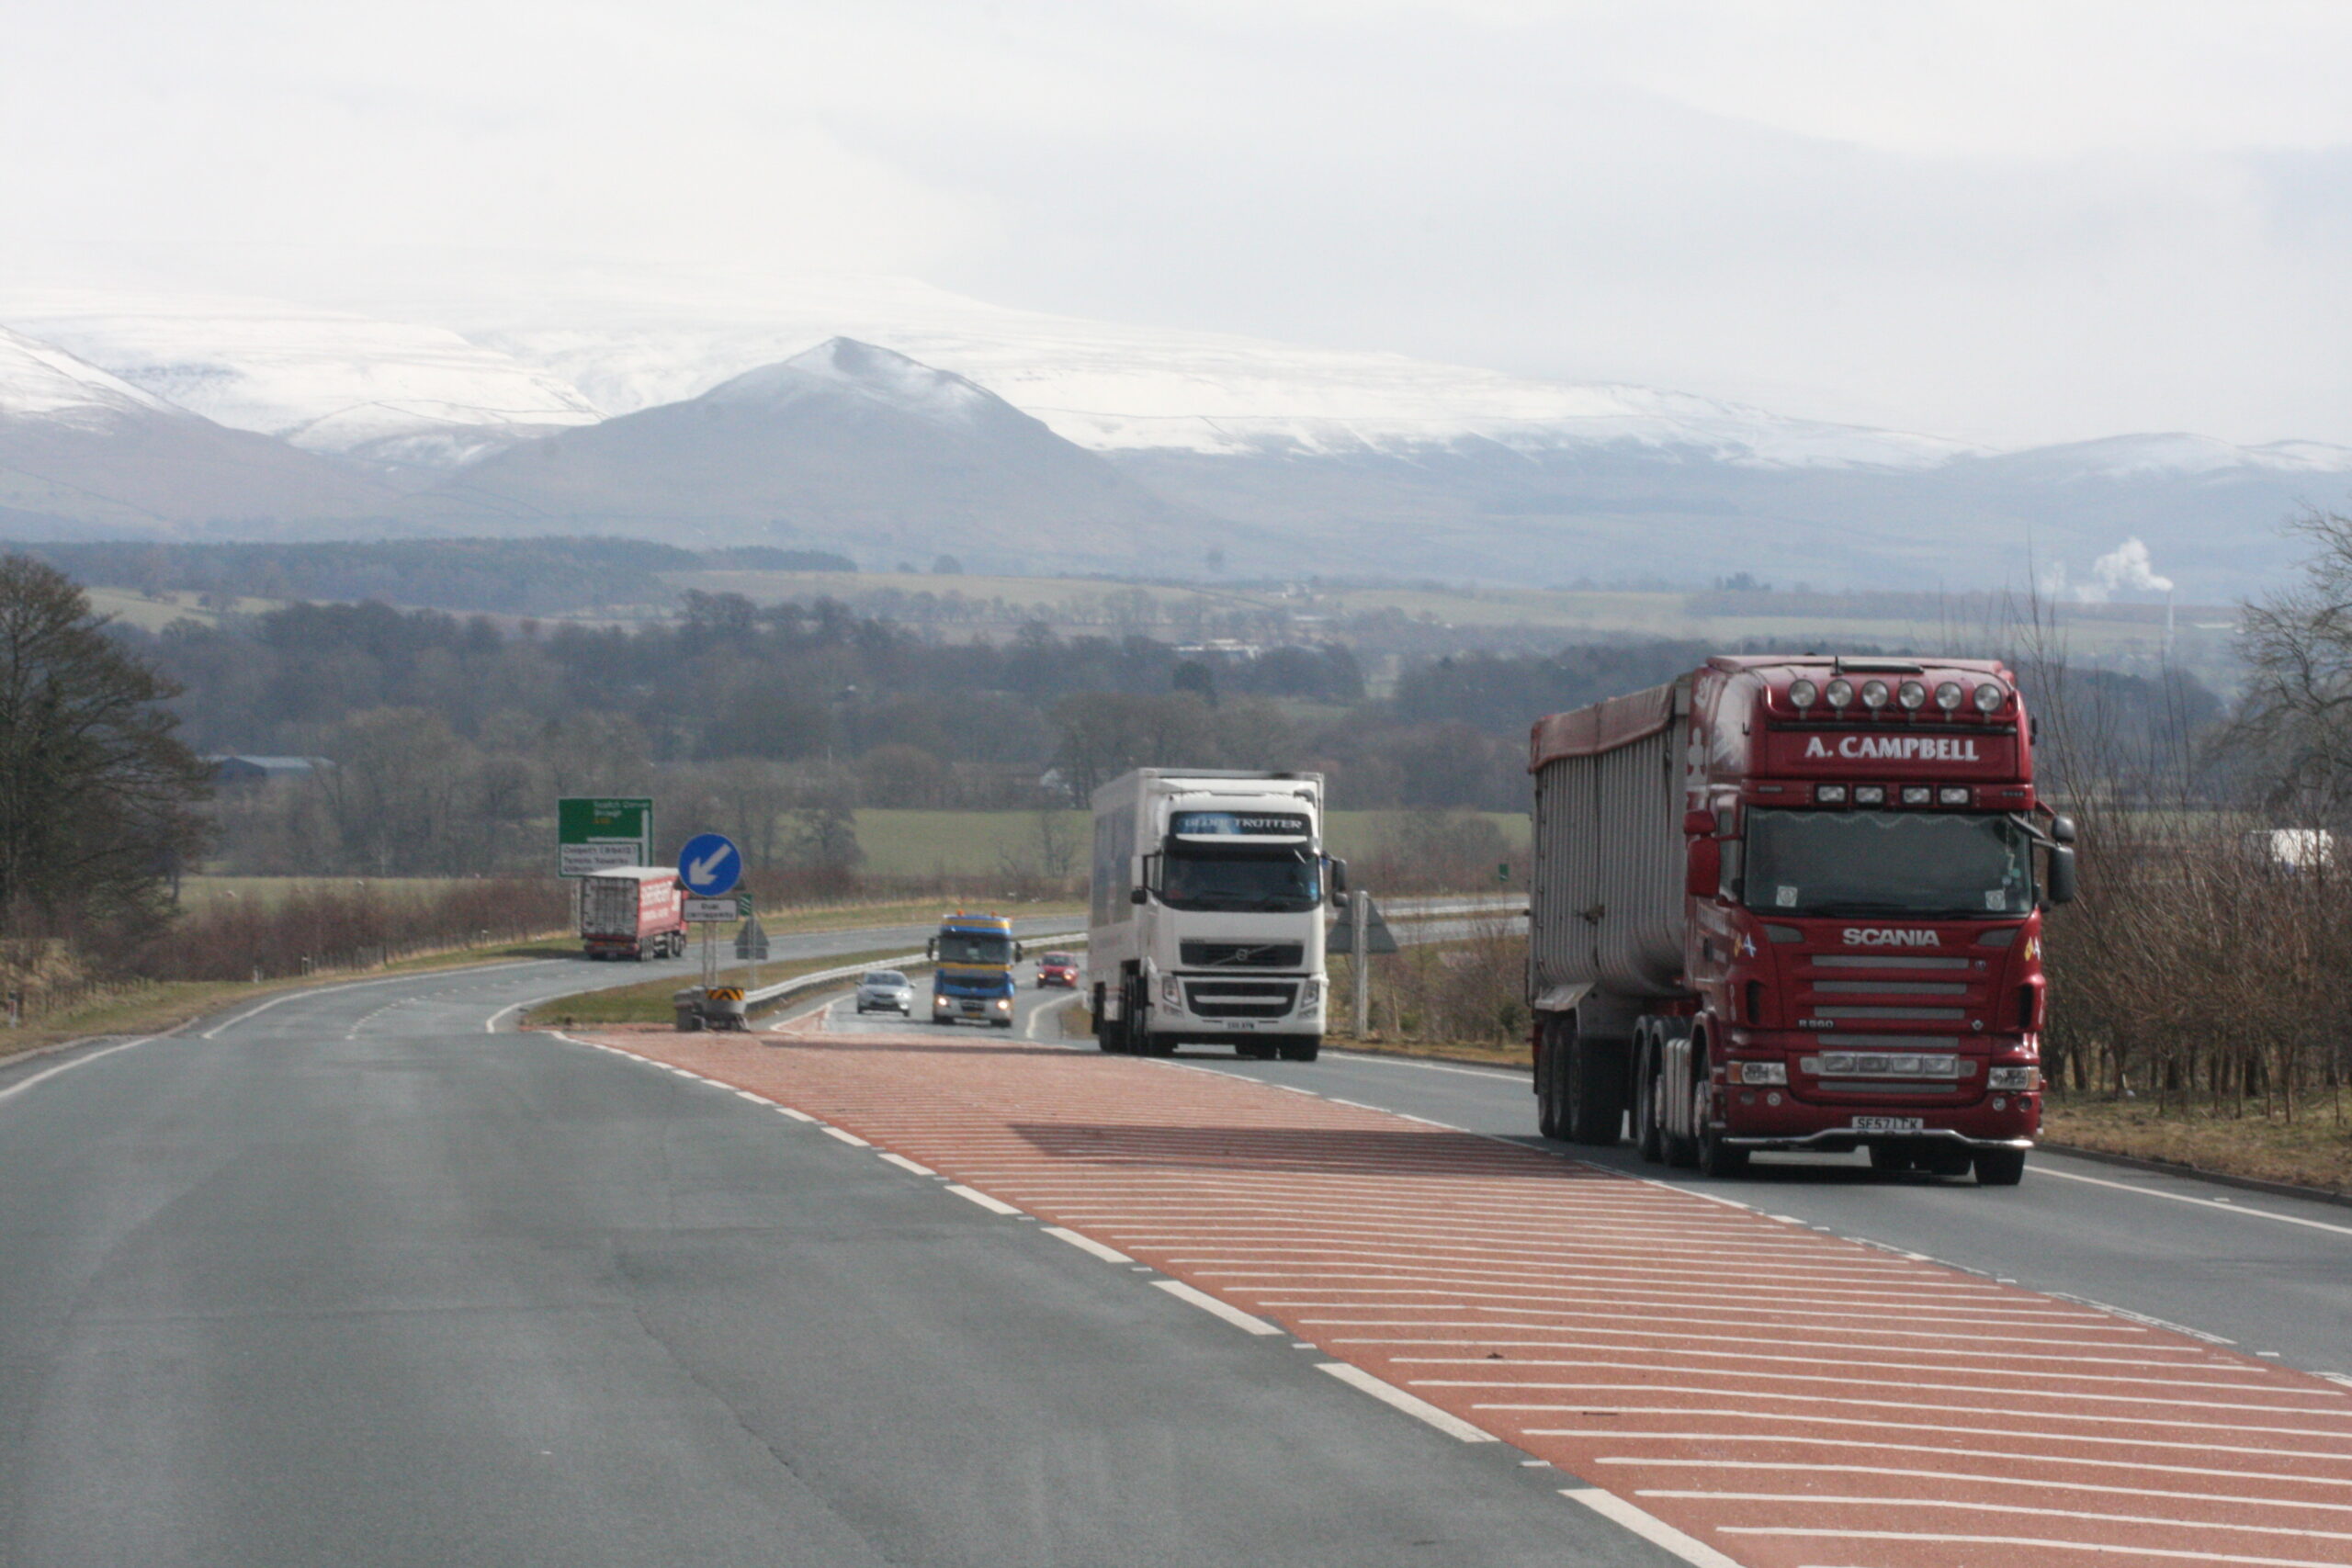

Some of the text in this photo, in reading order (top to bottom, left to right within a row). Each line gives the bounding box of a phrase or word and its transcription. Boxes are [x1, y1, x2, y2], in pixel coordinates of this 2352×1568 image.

[1804, 737, 1980, 761] A. CAMPBELL
[1842, 928, 1940, 947] SCANIA
